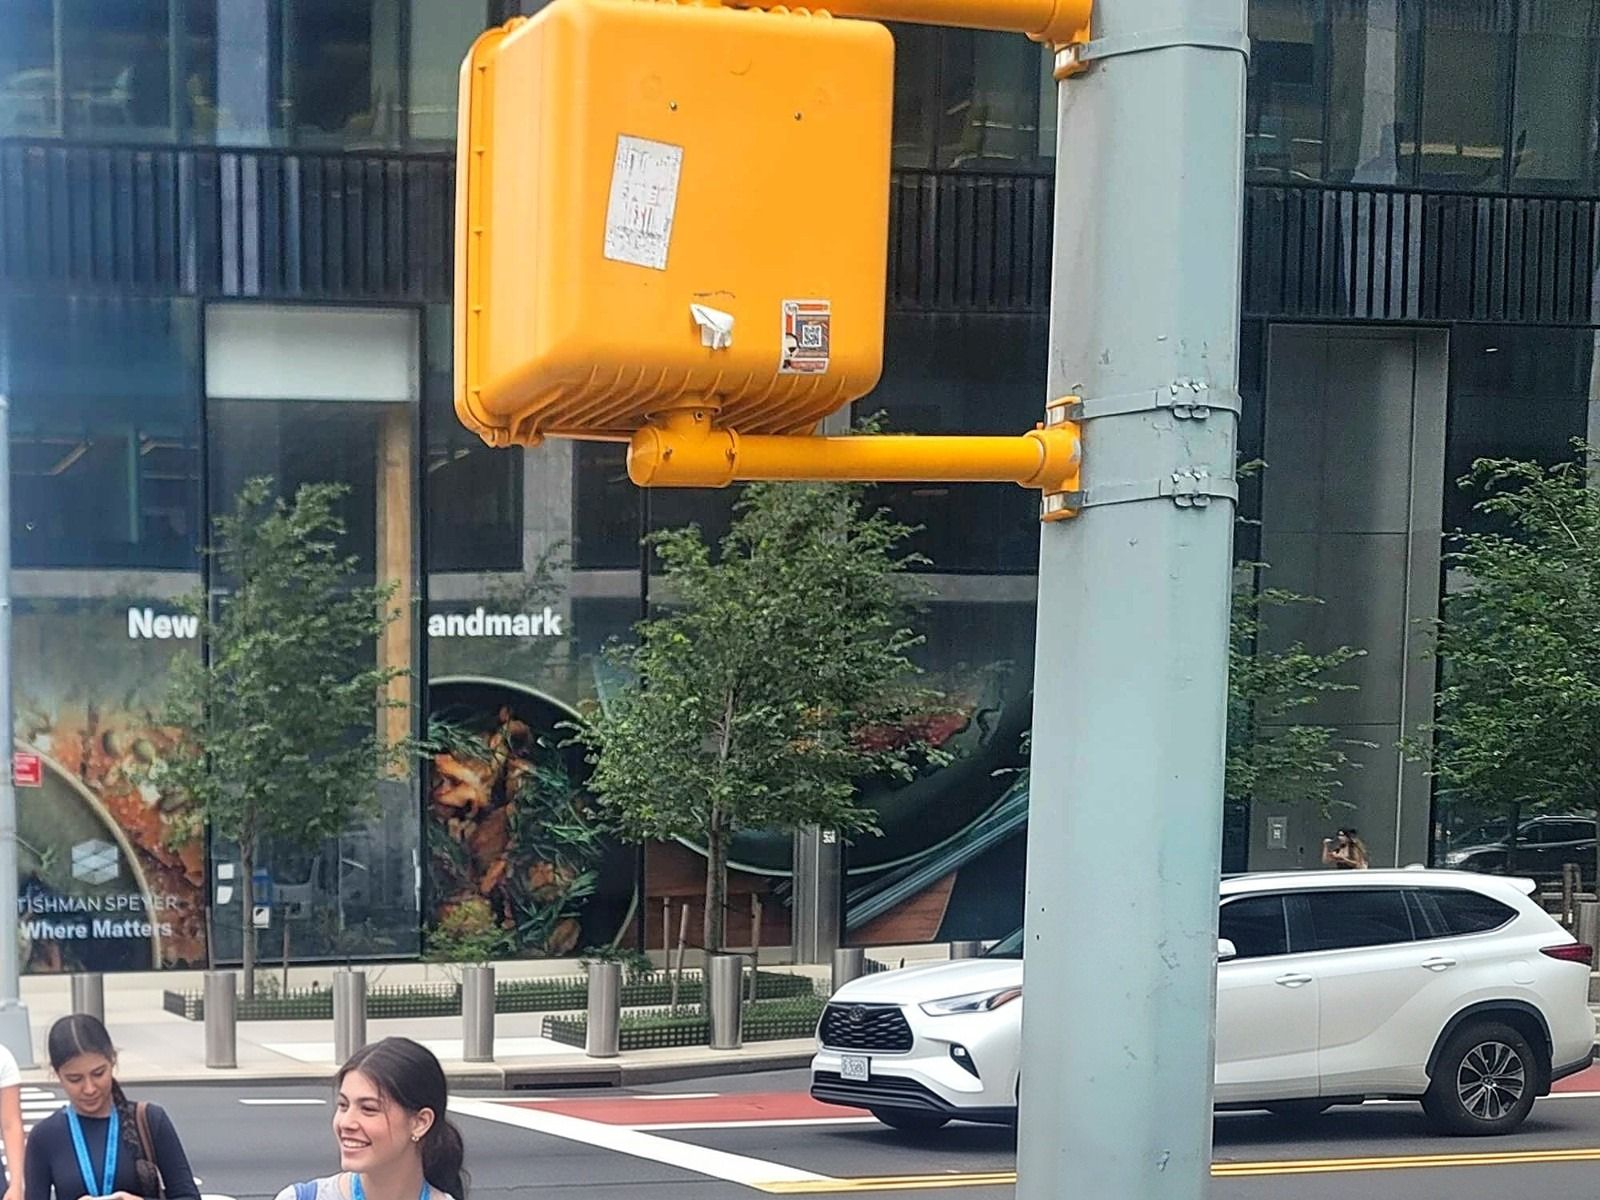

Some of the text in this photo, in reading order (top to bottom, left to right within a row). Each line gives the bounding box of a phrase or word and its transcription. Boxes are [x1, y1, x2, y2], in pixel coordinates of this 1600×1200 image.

[128, 607, 199, 639] New
[17, 893, 179, 914] TISHMAN SPEYER
[20, 918, 173, 940] Where Matters
